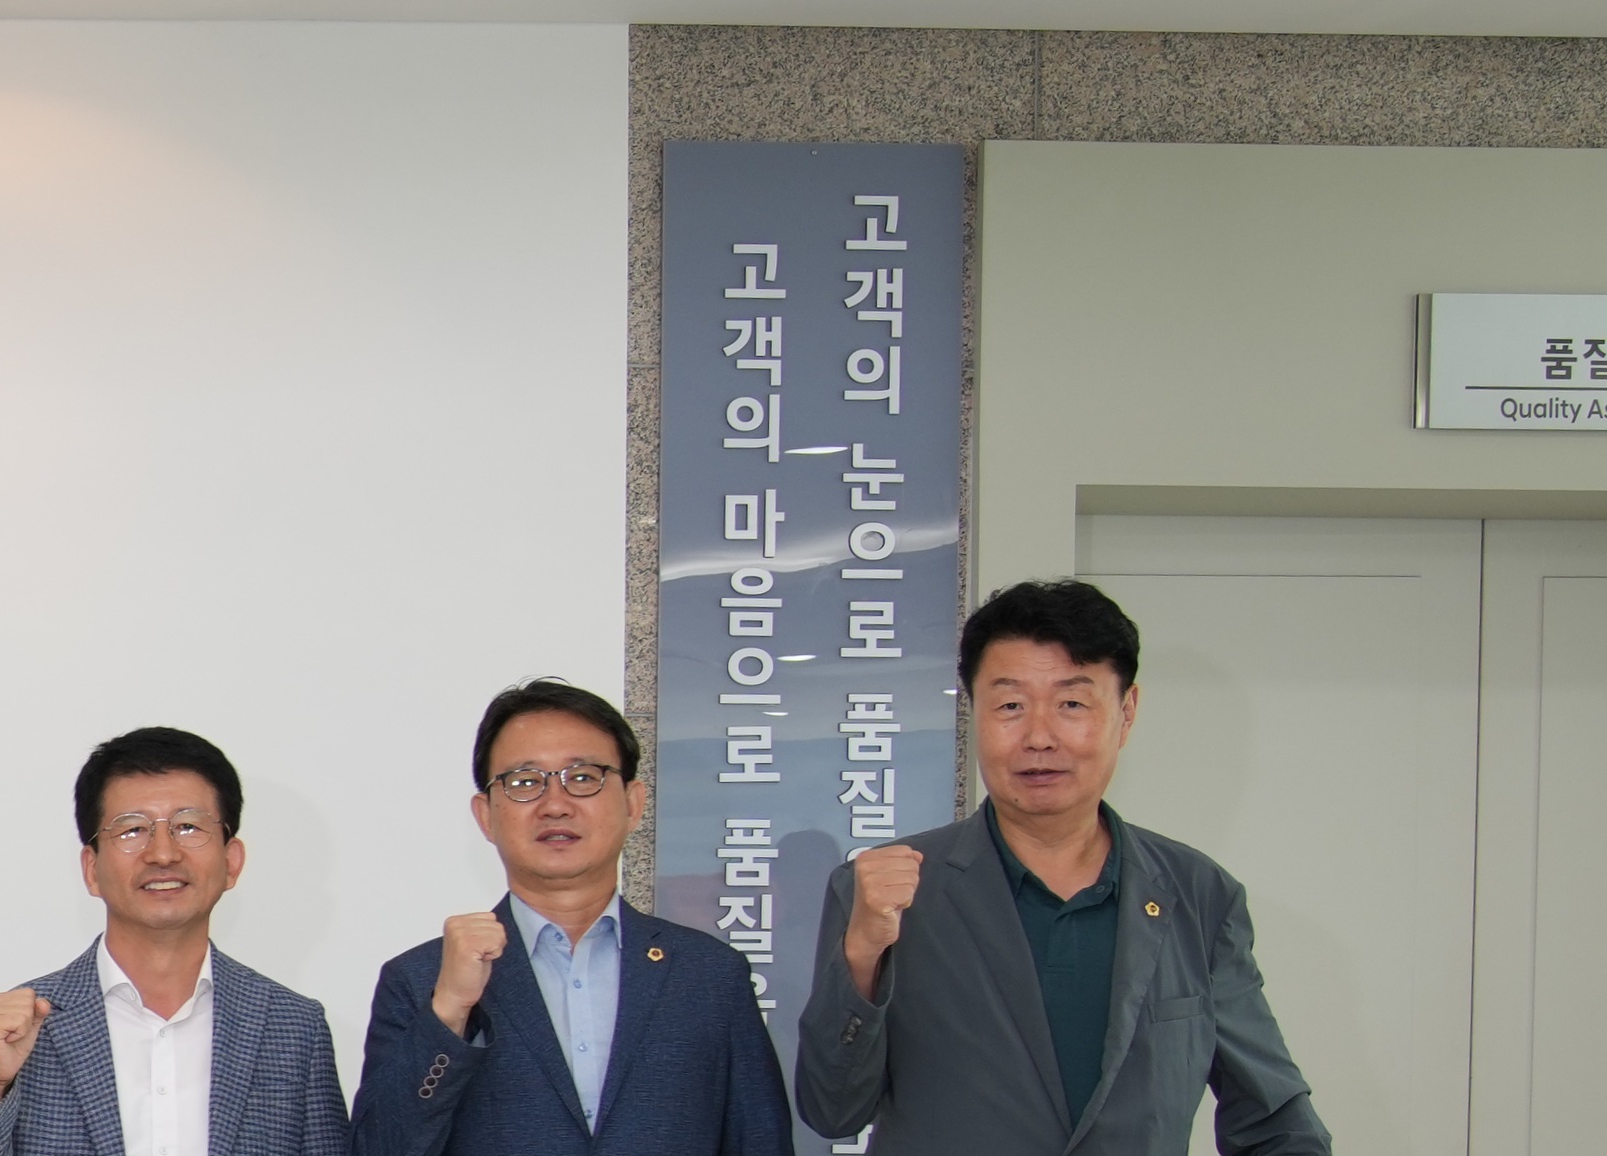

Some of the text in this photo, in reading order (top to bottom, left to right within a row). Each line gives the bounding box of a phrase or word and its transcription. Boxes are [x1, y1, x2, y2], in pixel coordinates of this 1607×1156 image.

[722, 243, 787, 463] 고객의
[1500, 397, 1607, 424] Quality A
[717, 488, 785, 783] 마음으로
[837, 195, 908, 863] 고객의 눈으로 품질
